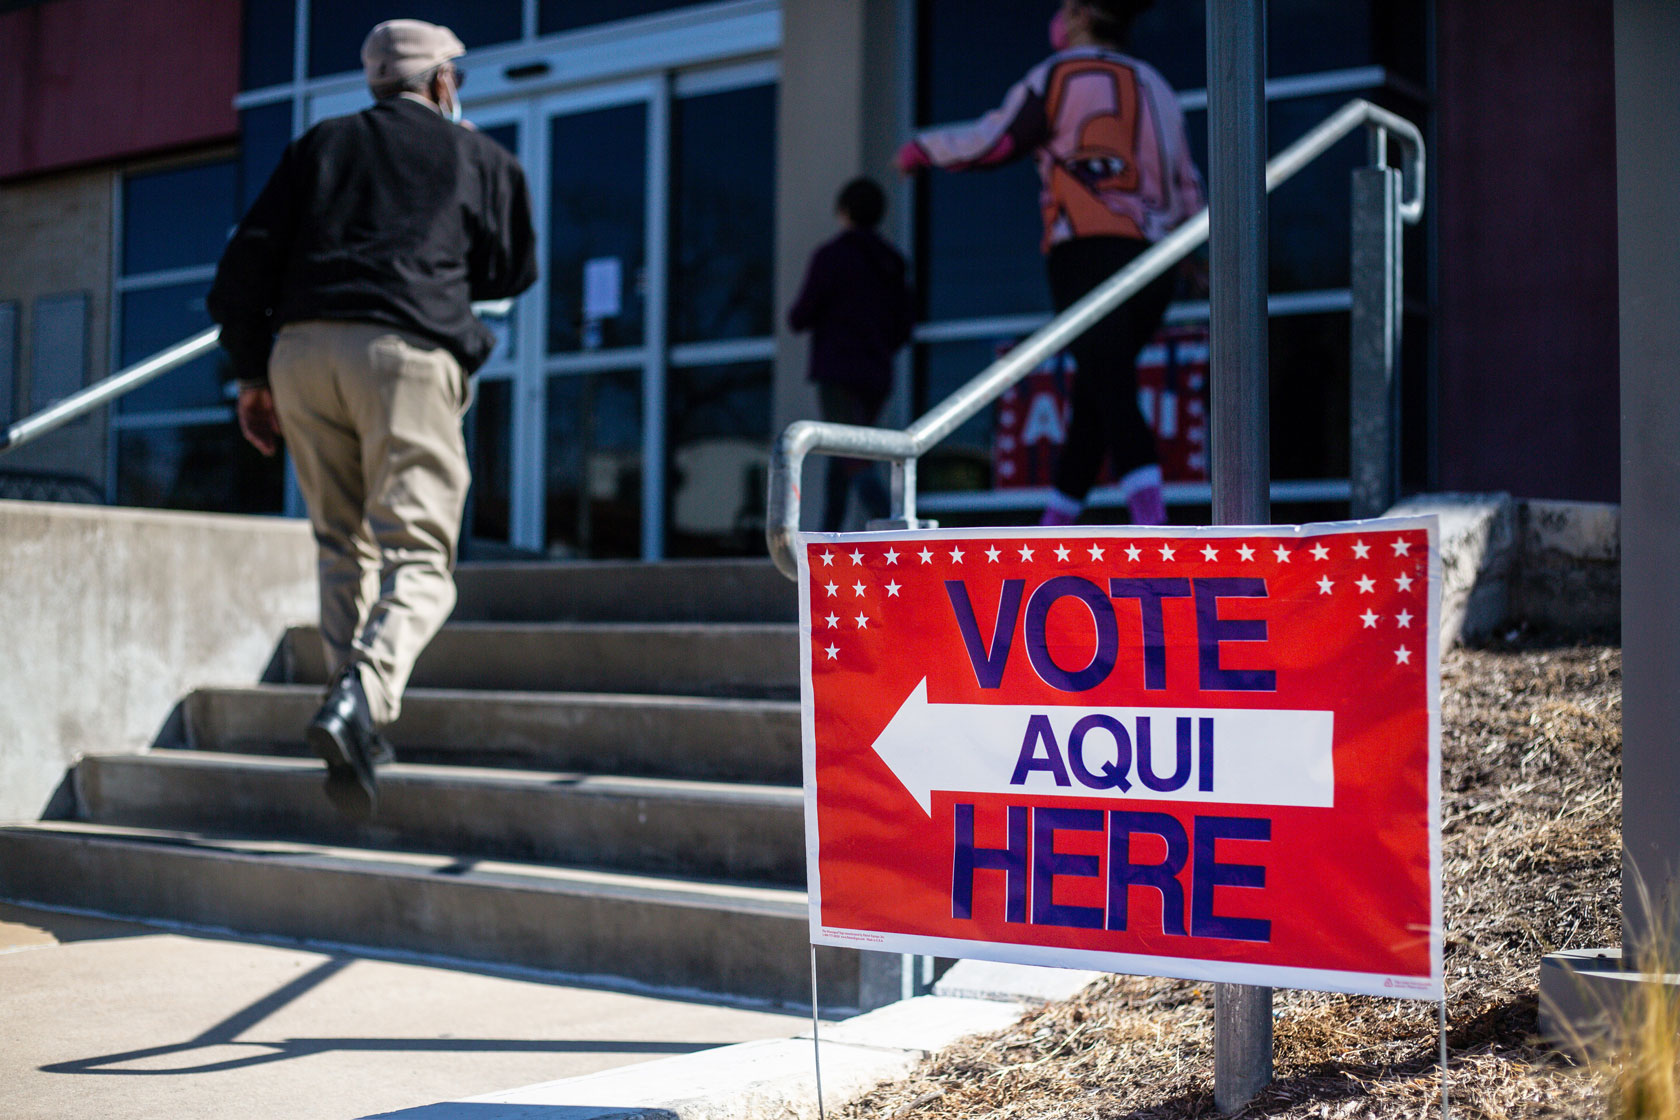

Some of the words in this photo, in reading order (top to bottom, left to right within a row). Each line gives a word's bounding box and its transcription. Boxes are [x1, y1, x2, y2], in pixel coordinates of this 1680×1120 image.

[944, 576, 1277, 693] VOTE
[1010, 714, 1215, 794] AQUI
[951, 803, 1272, 943] HERE
